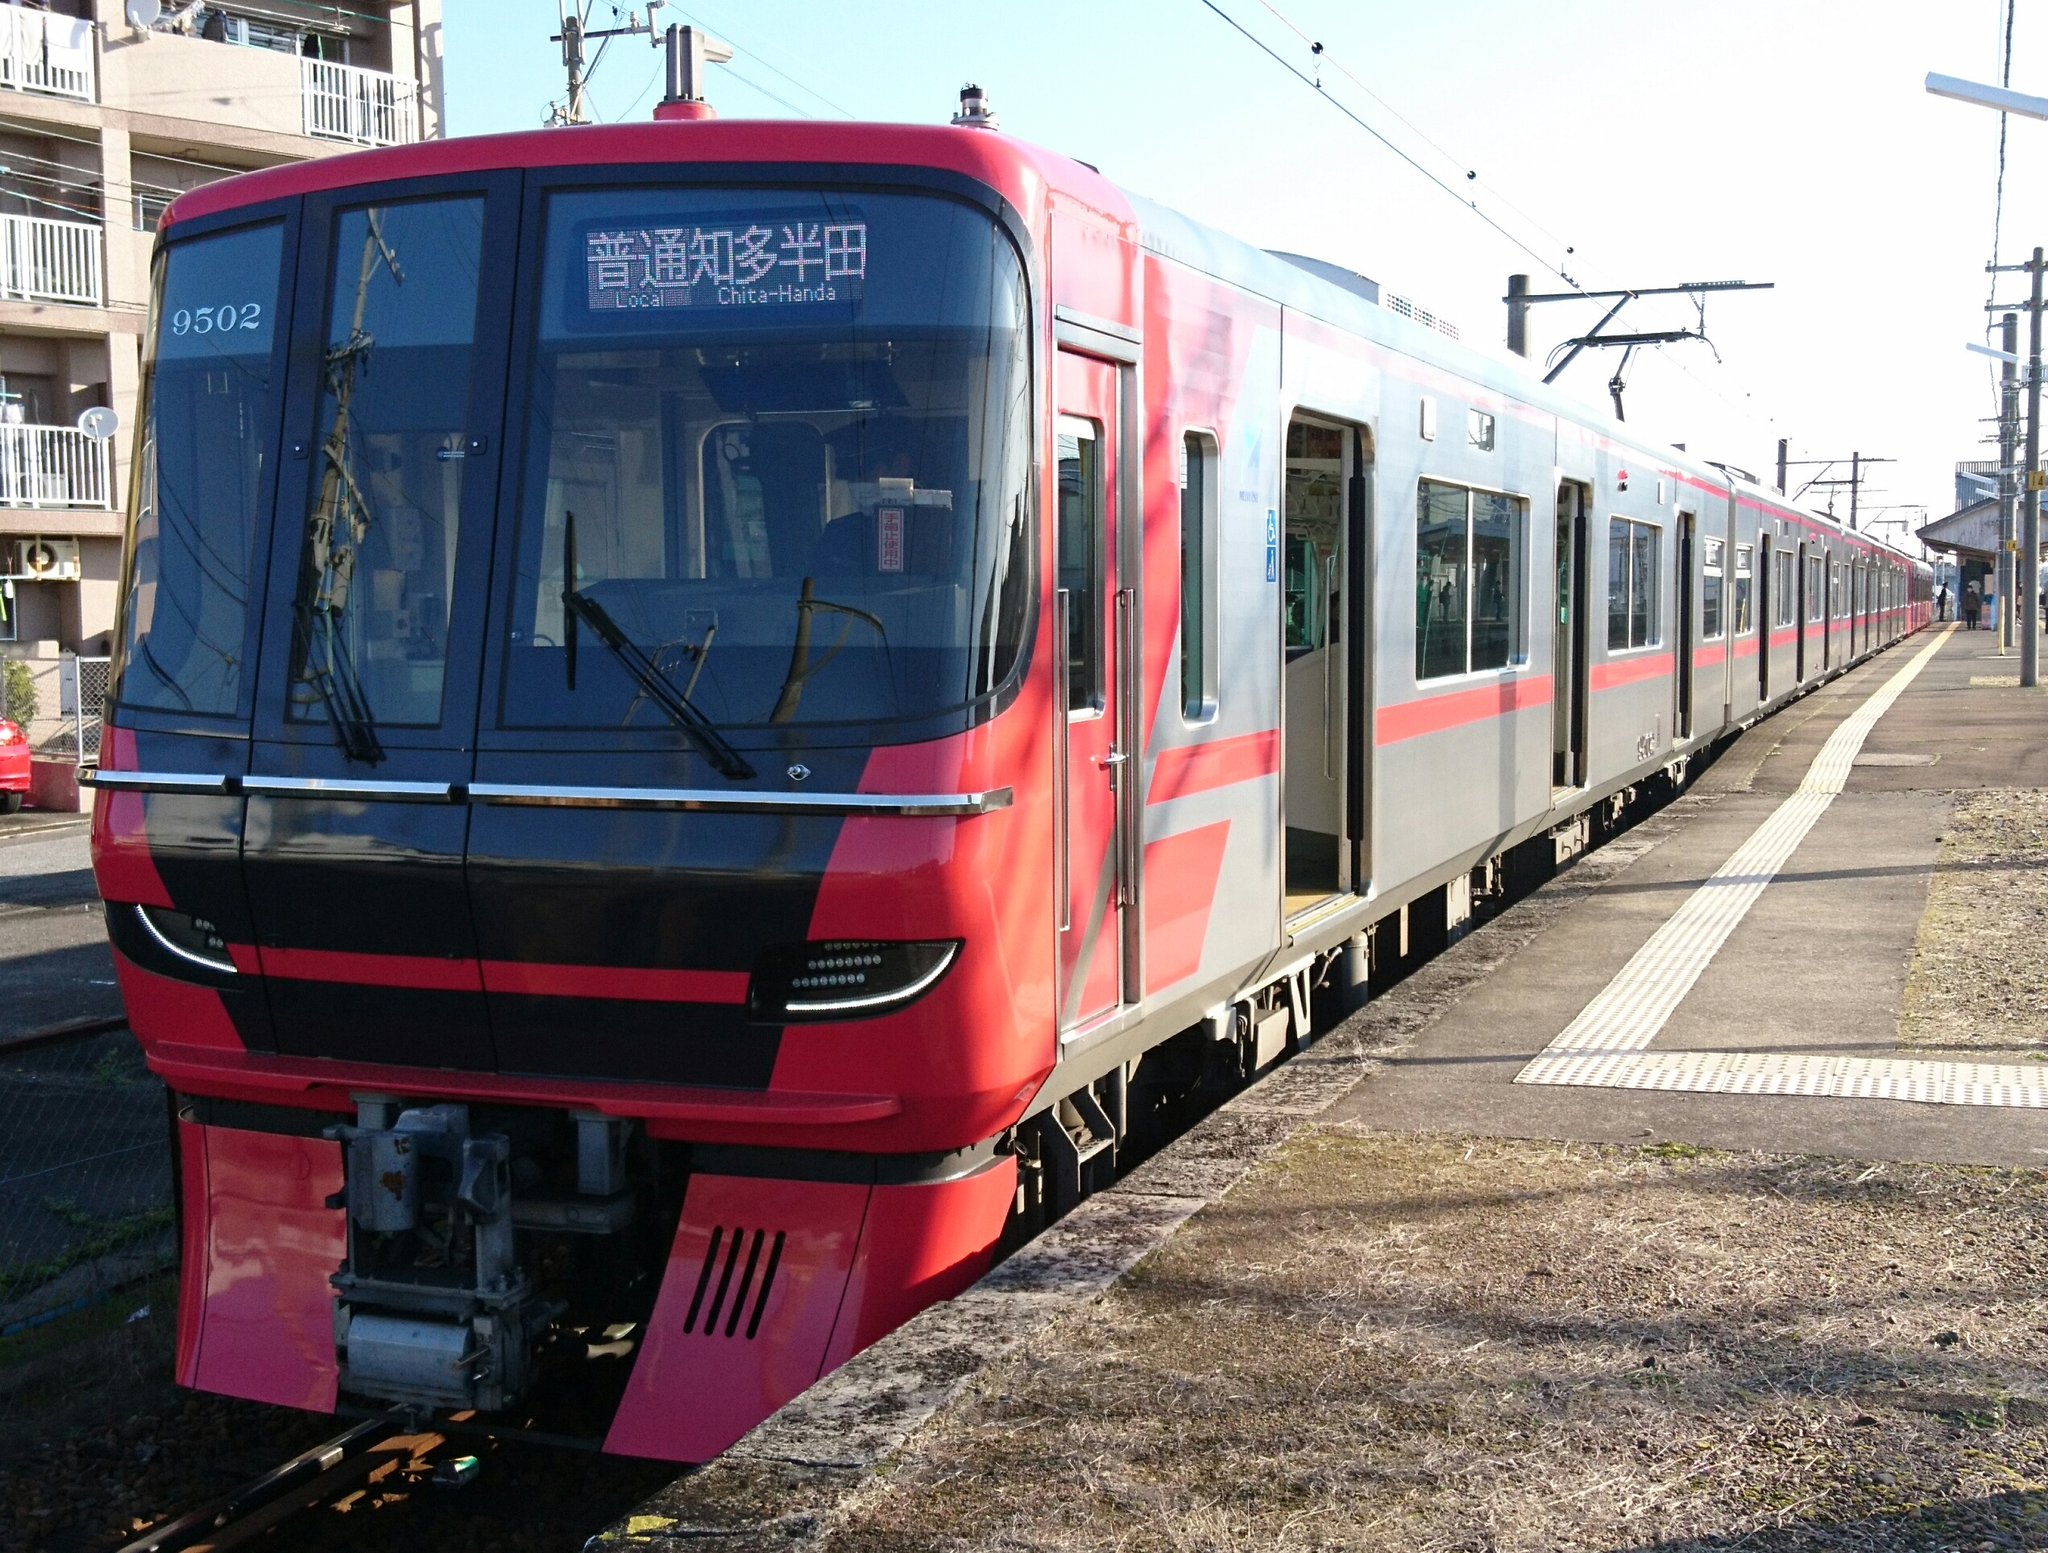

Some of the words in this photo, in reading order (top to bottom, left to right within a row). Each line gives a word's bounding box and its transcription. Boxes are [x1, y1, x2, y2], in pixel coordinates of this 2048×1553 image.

[616, 292, 664, 309] Local
[717, 283, 836, 305] Chita-Handa
[172, 303, 261, 335] 9502
